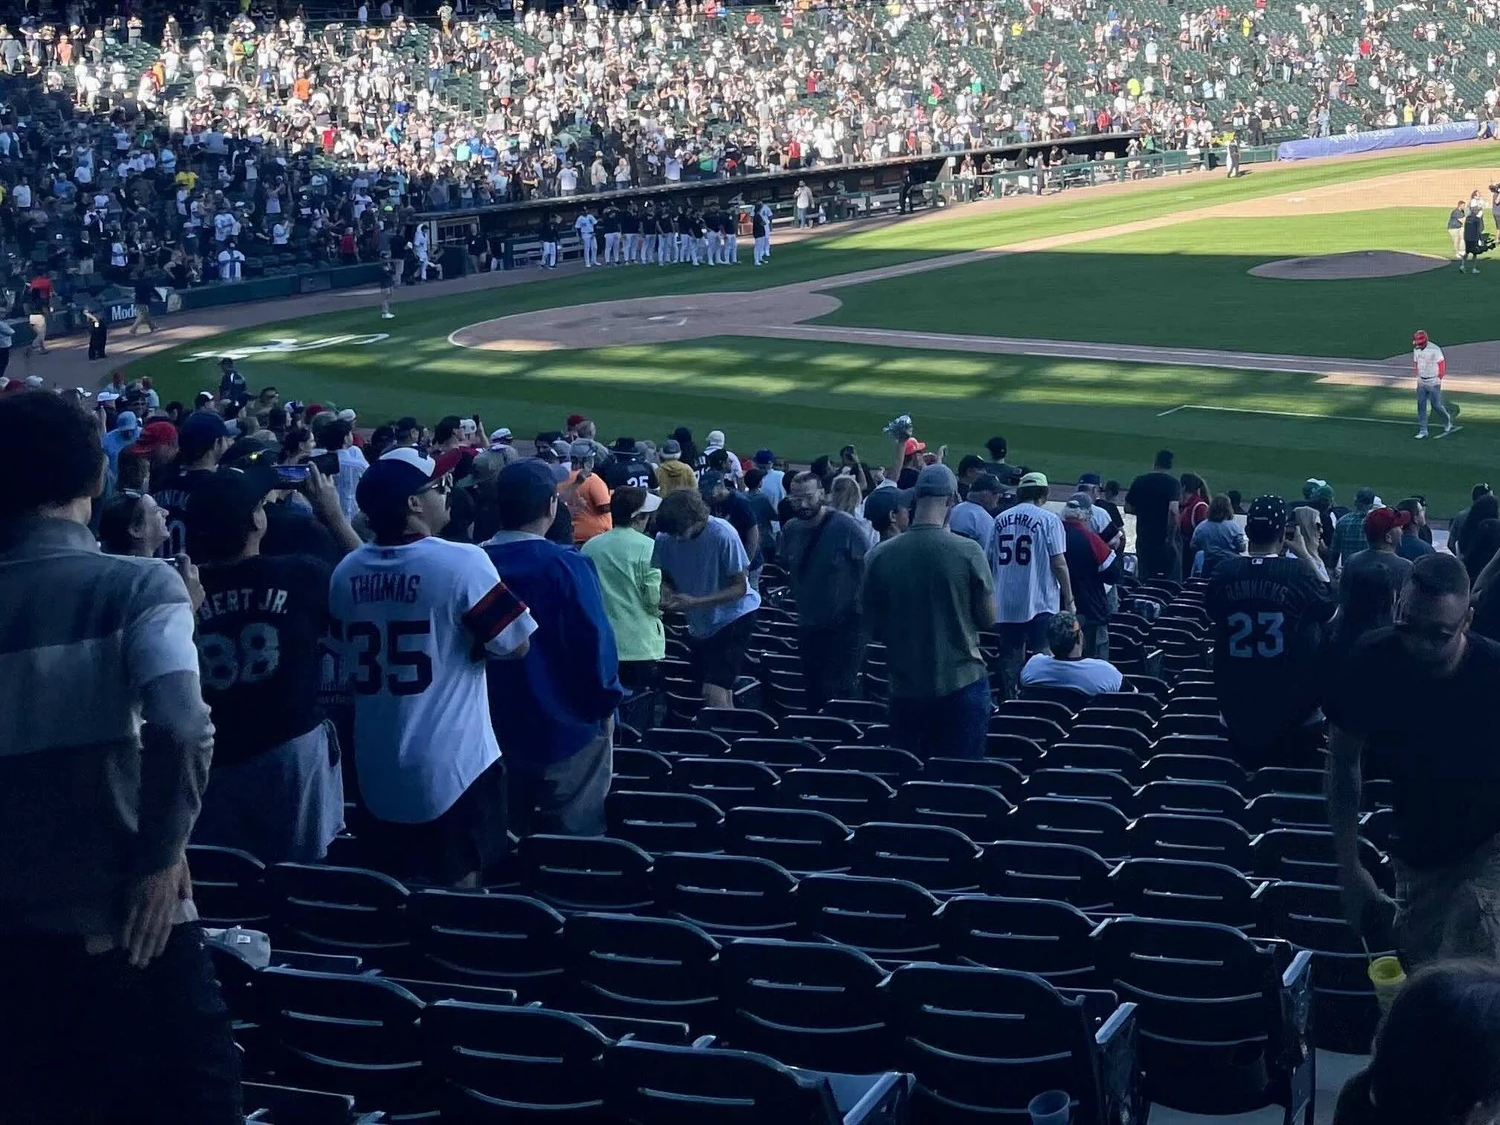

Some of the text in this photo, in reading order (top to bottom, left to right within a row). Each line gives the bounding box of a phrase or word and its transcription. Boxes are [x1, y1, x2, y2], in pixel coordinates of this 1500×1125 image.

[995, 513, 1043, 534] BUEHRLE
[999, 535, 1032, 565] 56
[200, 587, 289, 621] BERT JR.
[350, 572, 421, 604] THOMAS
[1226, 611, 1285, 658] 23
[198, 621, 280, 691] 88
[346, 619, 434, 696] 35
